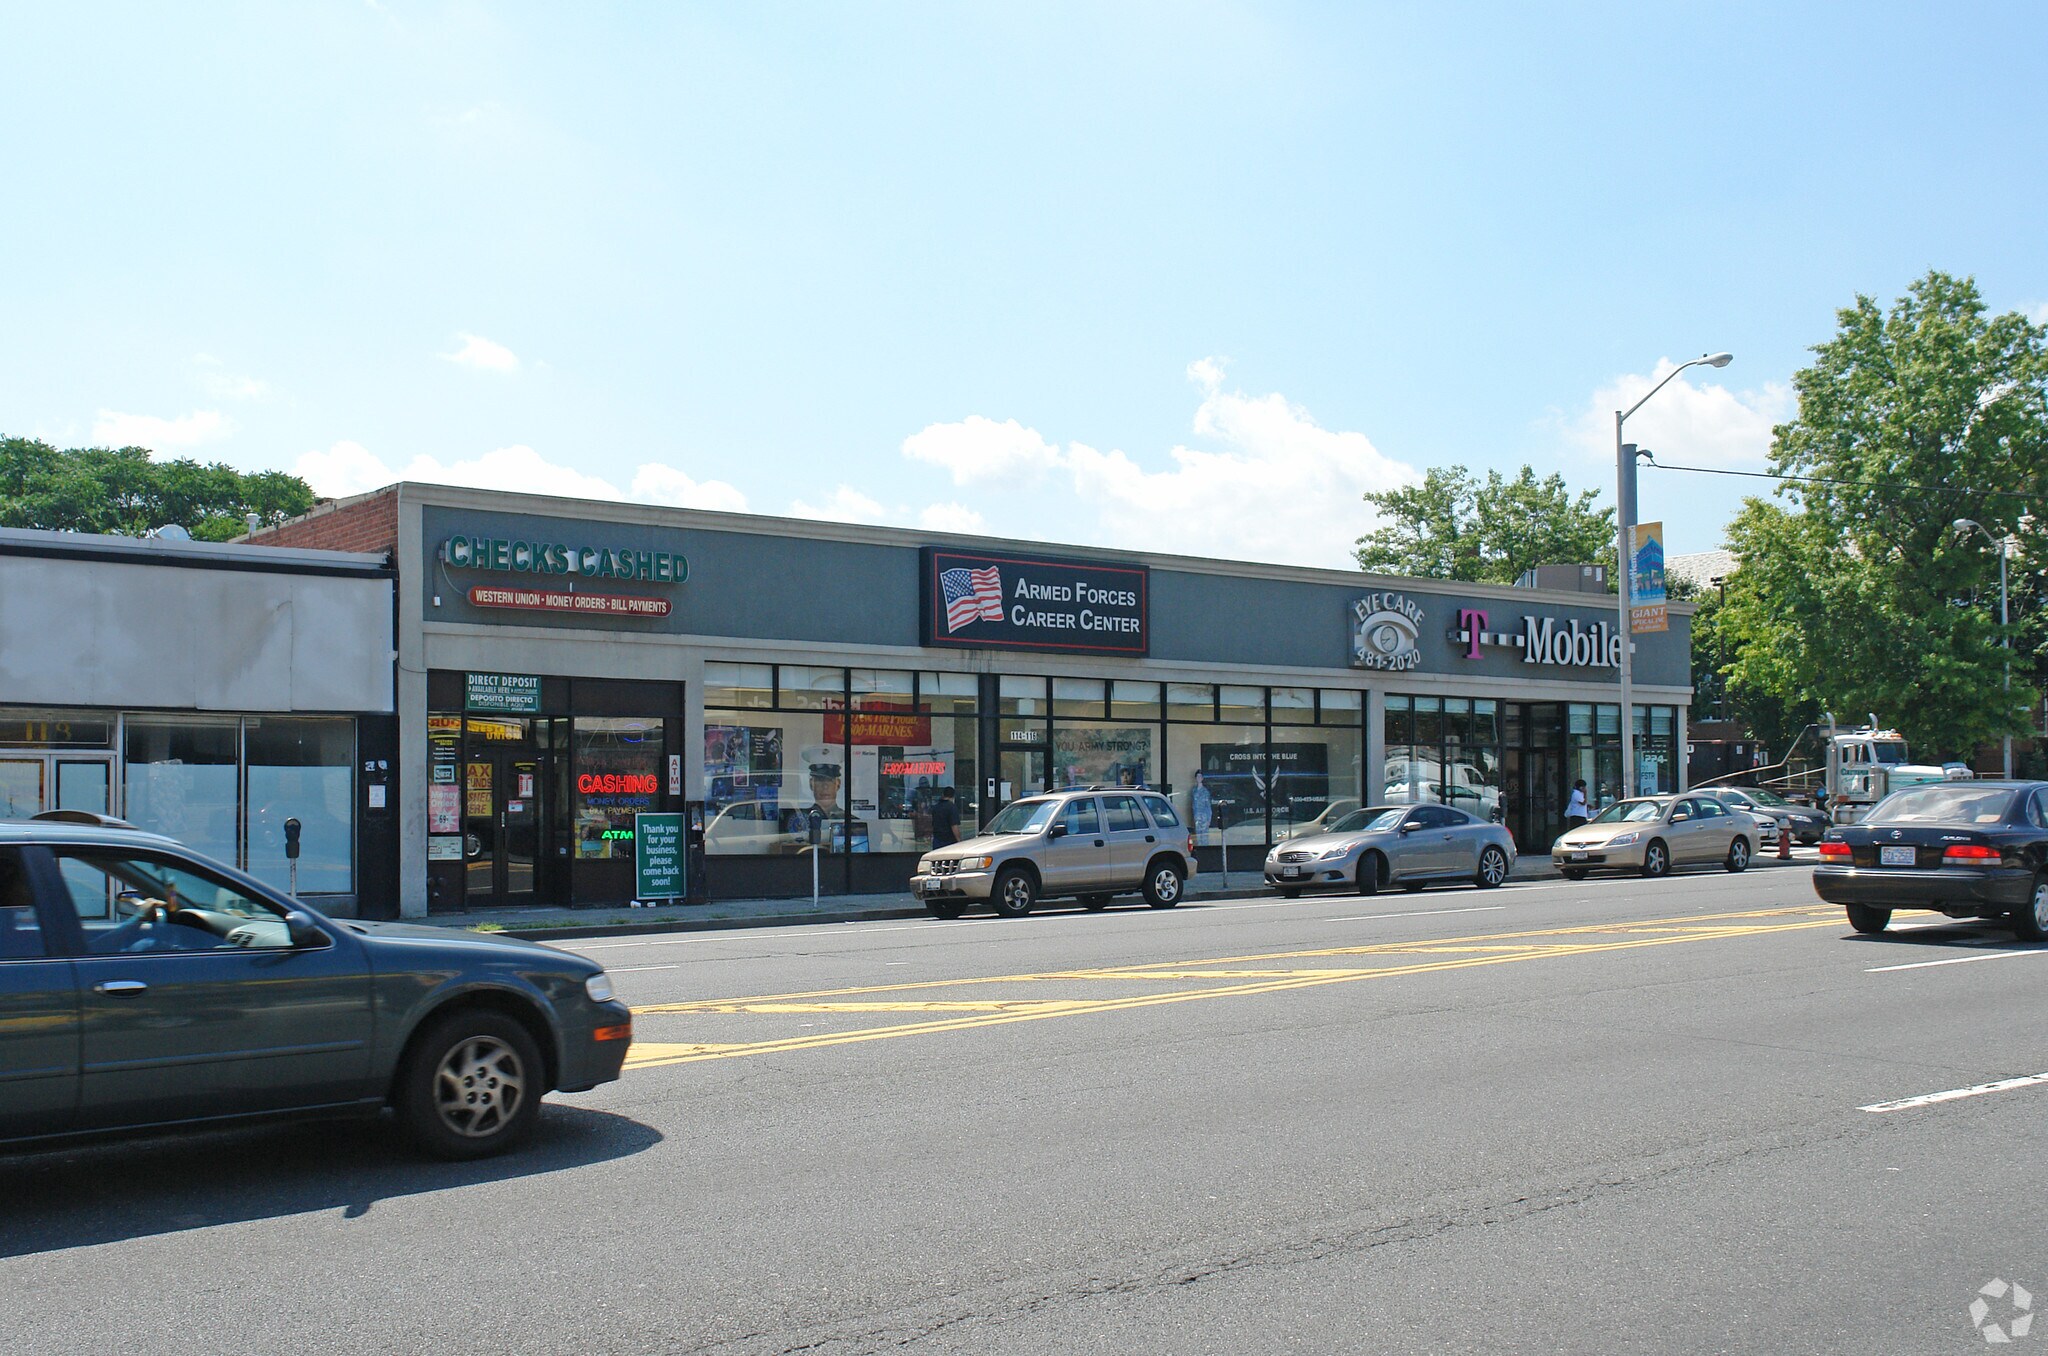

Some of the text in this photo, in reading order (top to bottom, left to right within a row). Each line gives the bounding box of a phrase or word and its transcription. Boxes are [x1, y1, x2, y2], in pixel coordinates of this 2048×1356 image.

[449, 535, 689, 583] CHECKS CASHED
[1015, 578, 1136, 606] ARMED FORCES
[475, 590, 667, 613] WESTERN UNION MONEY ORDERS BILL PAYMENTS
[1355, 592, 1425, 627] EYE CARE
[1632, 606, 1665, 618] GIANT
[1012, 604, 1140, 633] CAREER CENTER
[1357, 648, 1421, 671] 481-2020
[468, 674, 538, 688] DIRECT DEPOSIT
[470, 694, 503, 702] DEPOSITO
[486, 732, 521, 740] UNION
[1056, 741, 1147, 751] YOU ARMY STRONG?
[671, 759, 679, 784] ATM
[882, 762, 945, 775] 1-800-MARINES
[578, 774, 657, 793] CASHING
[432, 791, 458, 801] Money
[587, 797, 650, 805] MONEY ORDERS
[608, 806, 647, 814] PAYMENTS
[602, 830, 633, 839] ATM
[643, 824, 679, 835] Thank you
[648, 835, 676, 845] for your
[646, 846, 678, 855] business,
[650, 856, 672, 867] please
[643, 866, 679, 876] come back
[652, 877, 671, 886] soon!
